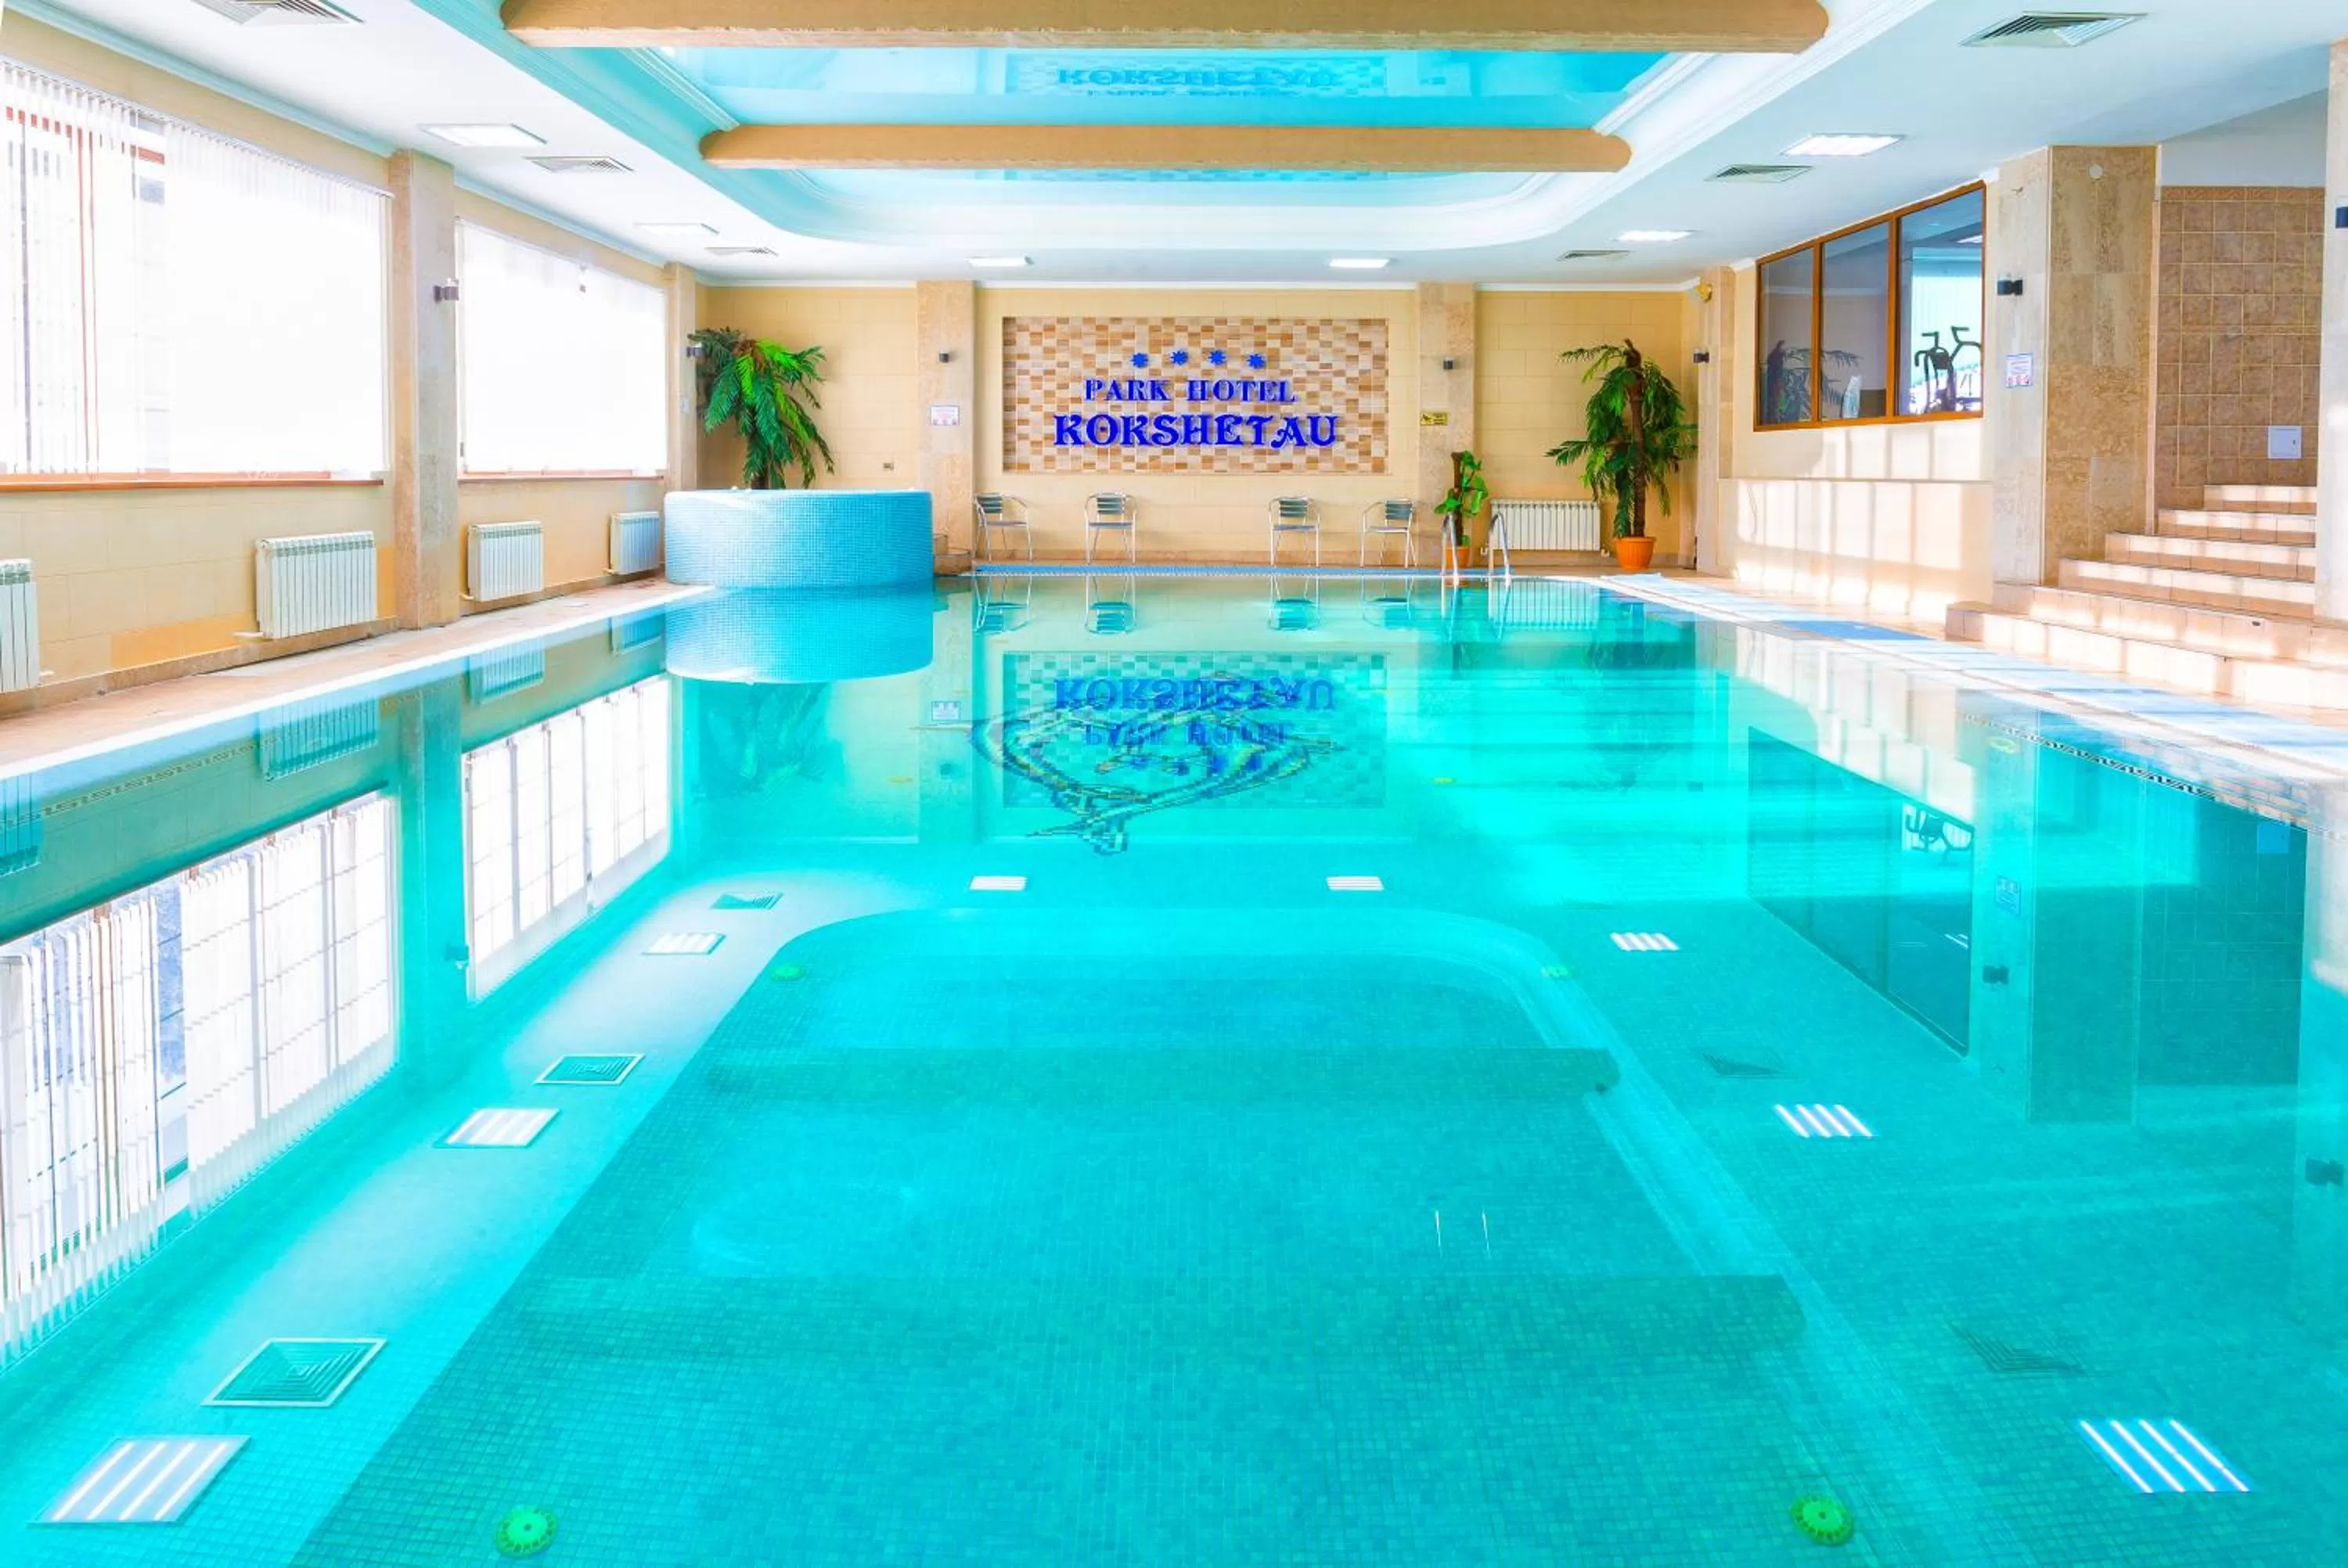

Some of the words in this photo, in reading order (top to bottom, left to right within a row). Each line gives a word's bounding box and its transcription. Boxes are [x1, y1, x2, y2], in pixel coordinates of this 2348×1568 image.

[1085, 379, 1172, 402] PARK
[1187, 379, 1298, 402] HOTEL
[1053, 414, 1337, 448] KOKSHETAU
